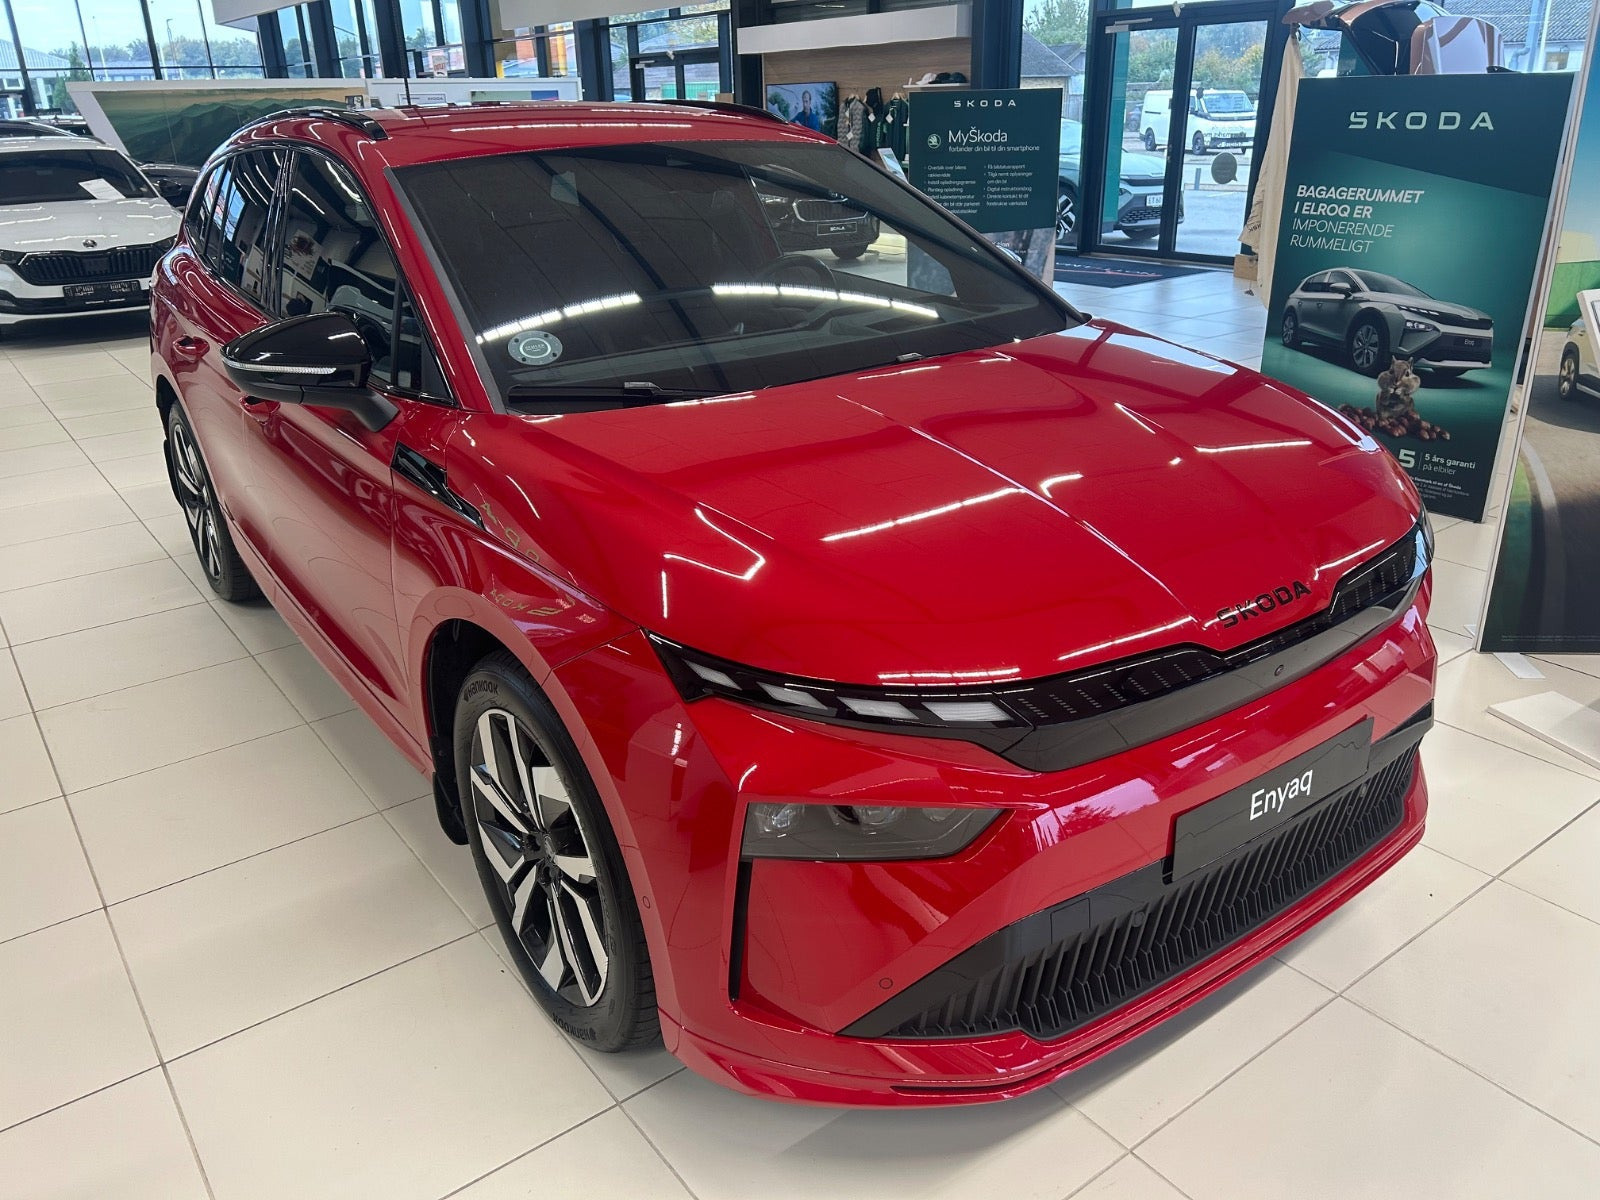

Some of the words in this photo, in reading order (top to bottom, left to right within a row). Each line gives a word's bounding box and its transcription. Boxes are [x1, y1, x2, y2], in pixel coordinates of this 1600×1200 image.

[954, 100, 1016, 108] SKODA
[1348, 111, 1494, 131] SKODA
[948, 126, 1008, 145] MyŠkoda
[1296, 184, 1424, 204] BAGAGERUMMET
[1294, 202, 1300, 214] I
[1302, 202, 1350, 218] ELROQ
[1353, 205, 1373, 219] ER
[1292, 218, 1395, 238] IMPONERENDE
[1290, 234, 1374, 253] RUMMELIGT
[1432, 454, 1444, 463] års
[1446, 458, 1476, 469] garanti
[1434, 465, 1456, 475] elbiler
[1216, 581, 1312, 628] SKODA
[1250, 769, 1313, 821] Enyaq
